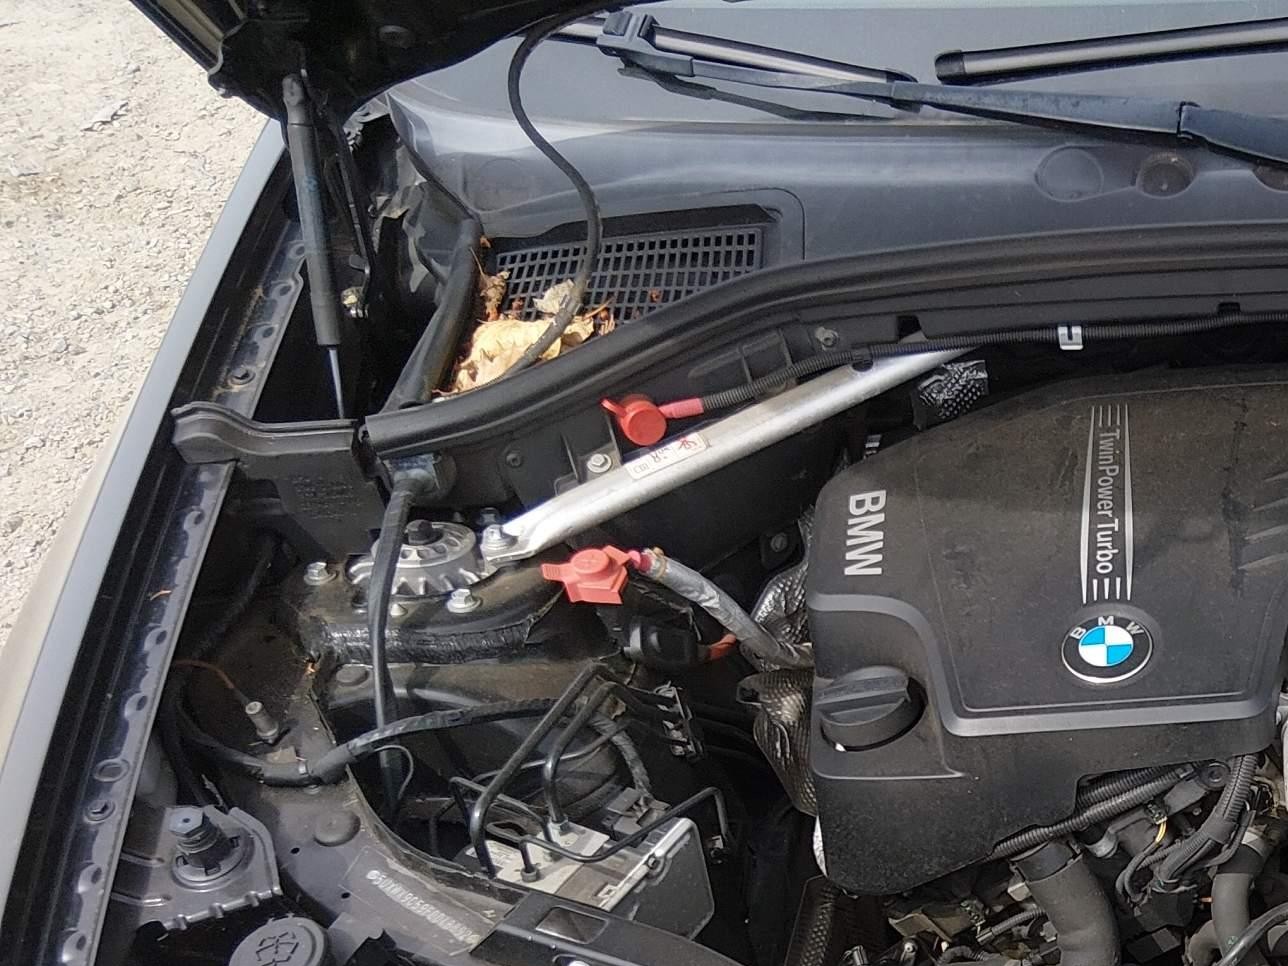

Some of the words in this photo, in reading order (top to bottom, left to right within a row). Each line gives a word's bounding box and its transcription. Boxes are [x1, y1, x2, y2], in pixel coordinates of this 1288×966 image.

[1097, 429, 1120, 517] TwinPower
[844, 489, 887, 576] BMW
[1096, 518, 1119, 574] Turbo
[1070, 615, 1144, 640] BMW
